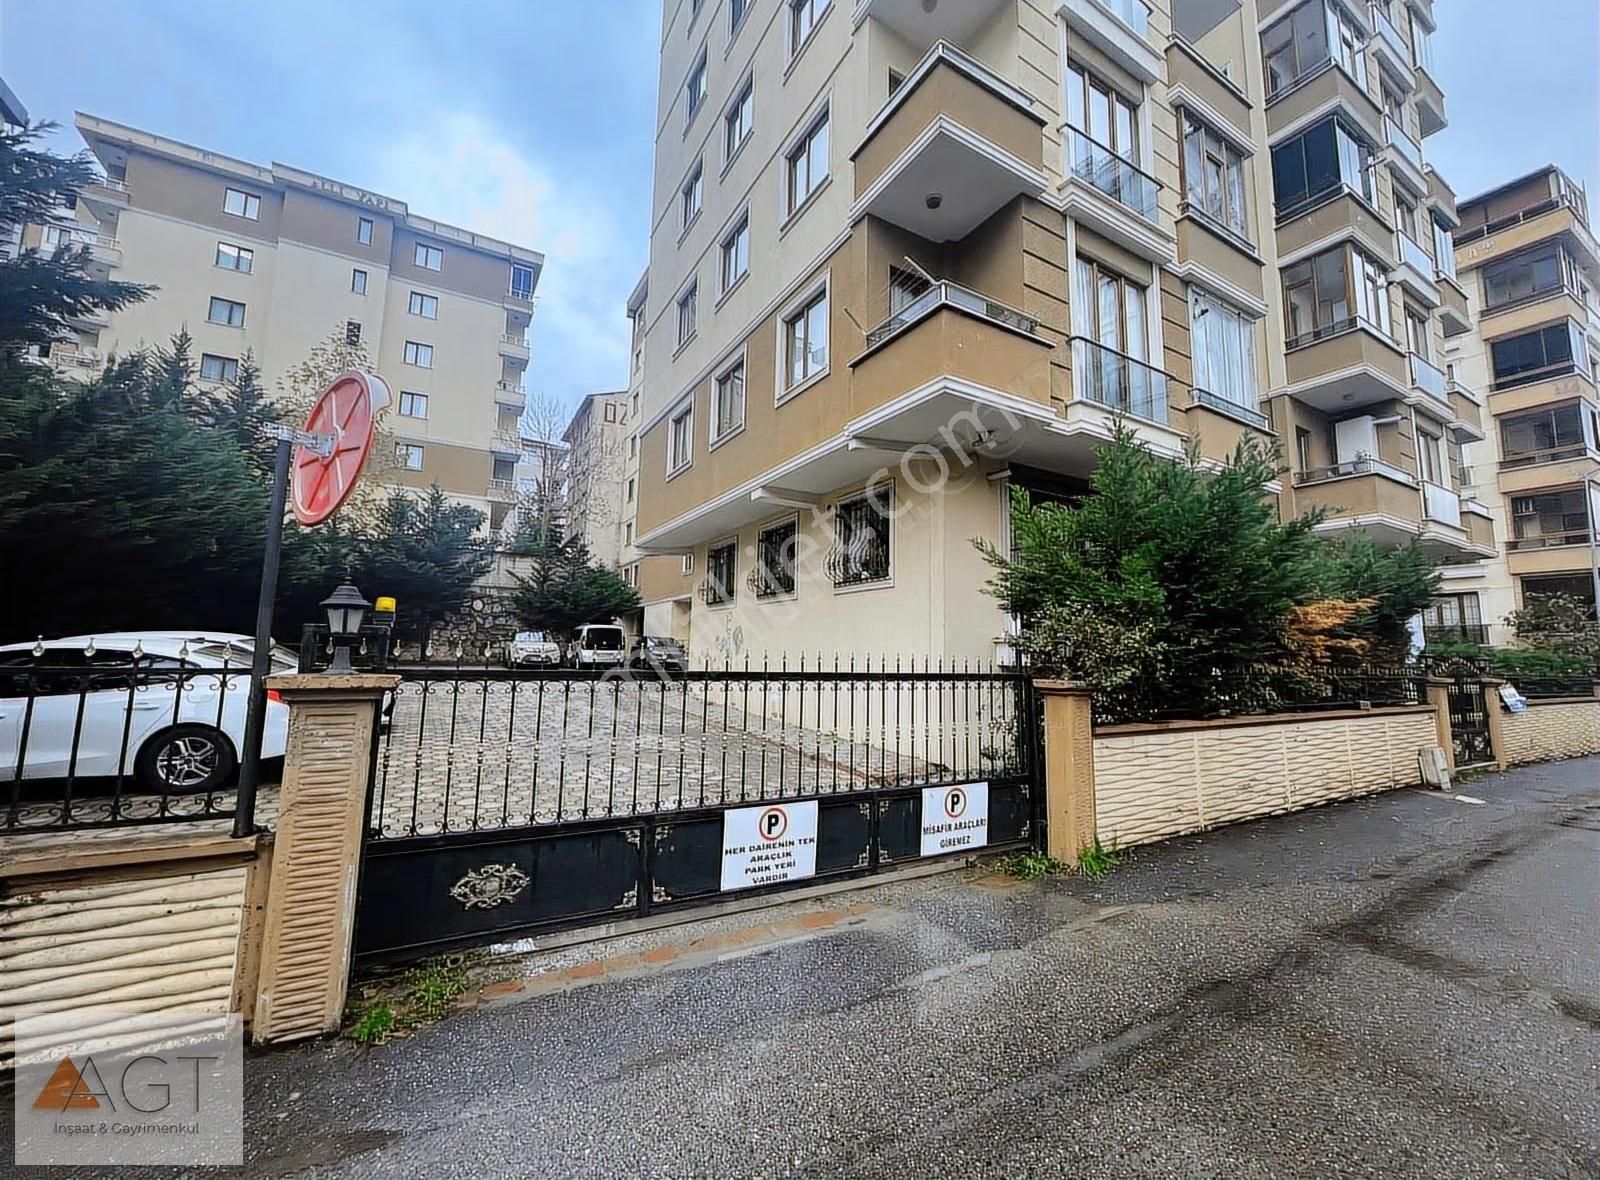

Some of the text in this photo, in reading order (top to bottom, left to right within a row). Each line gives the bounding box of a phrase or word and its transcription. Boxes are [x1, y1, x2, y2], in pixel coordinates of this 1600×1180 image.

[950, 793, 960, 813] P
[767, 814, 780, 835] P
[922, 822, 953, 836] MİSAFİR
[724, 836, 816, 855] HER DAİRENİN TEK
[744, 859, 796, 875] PARK YERİ
